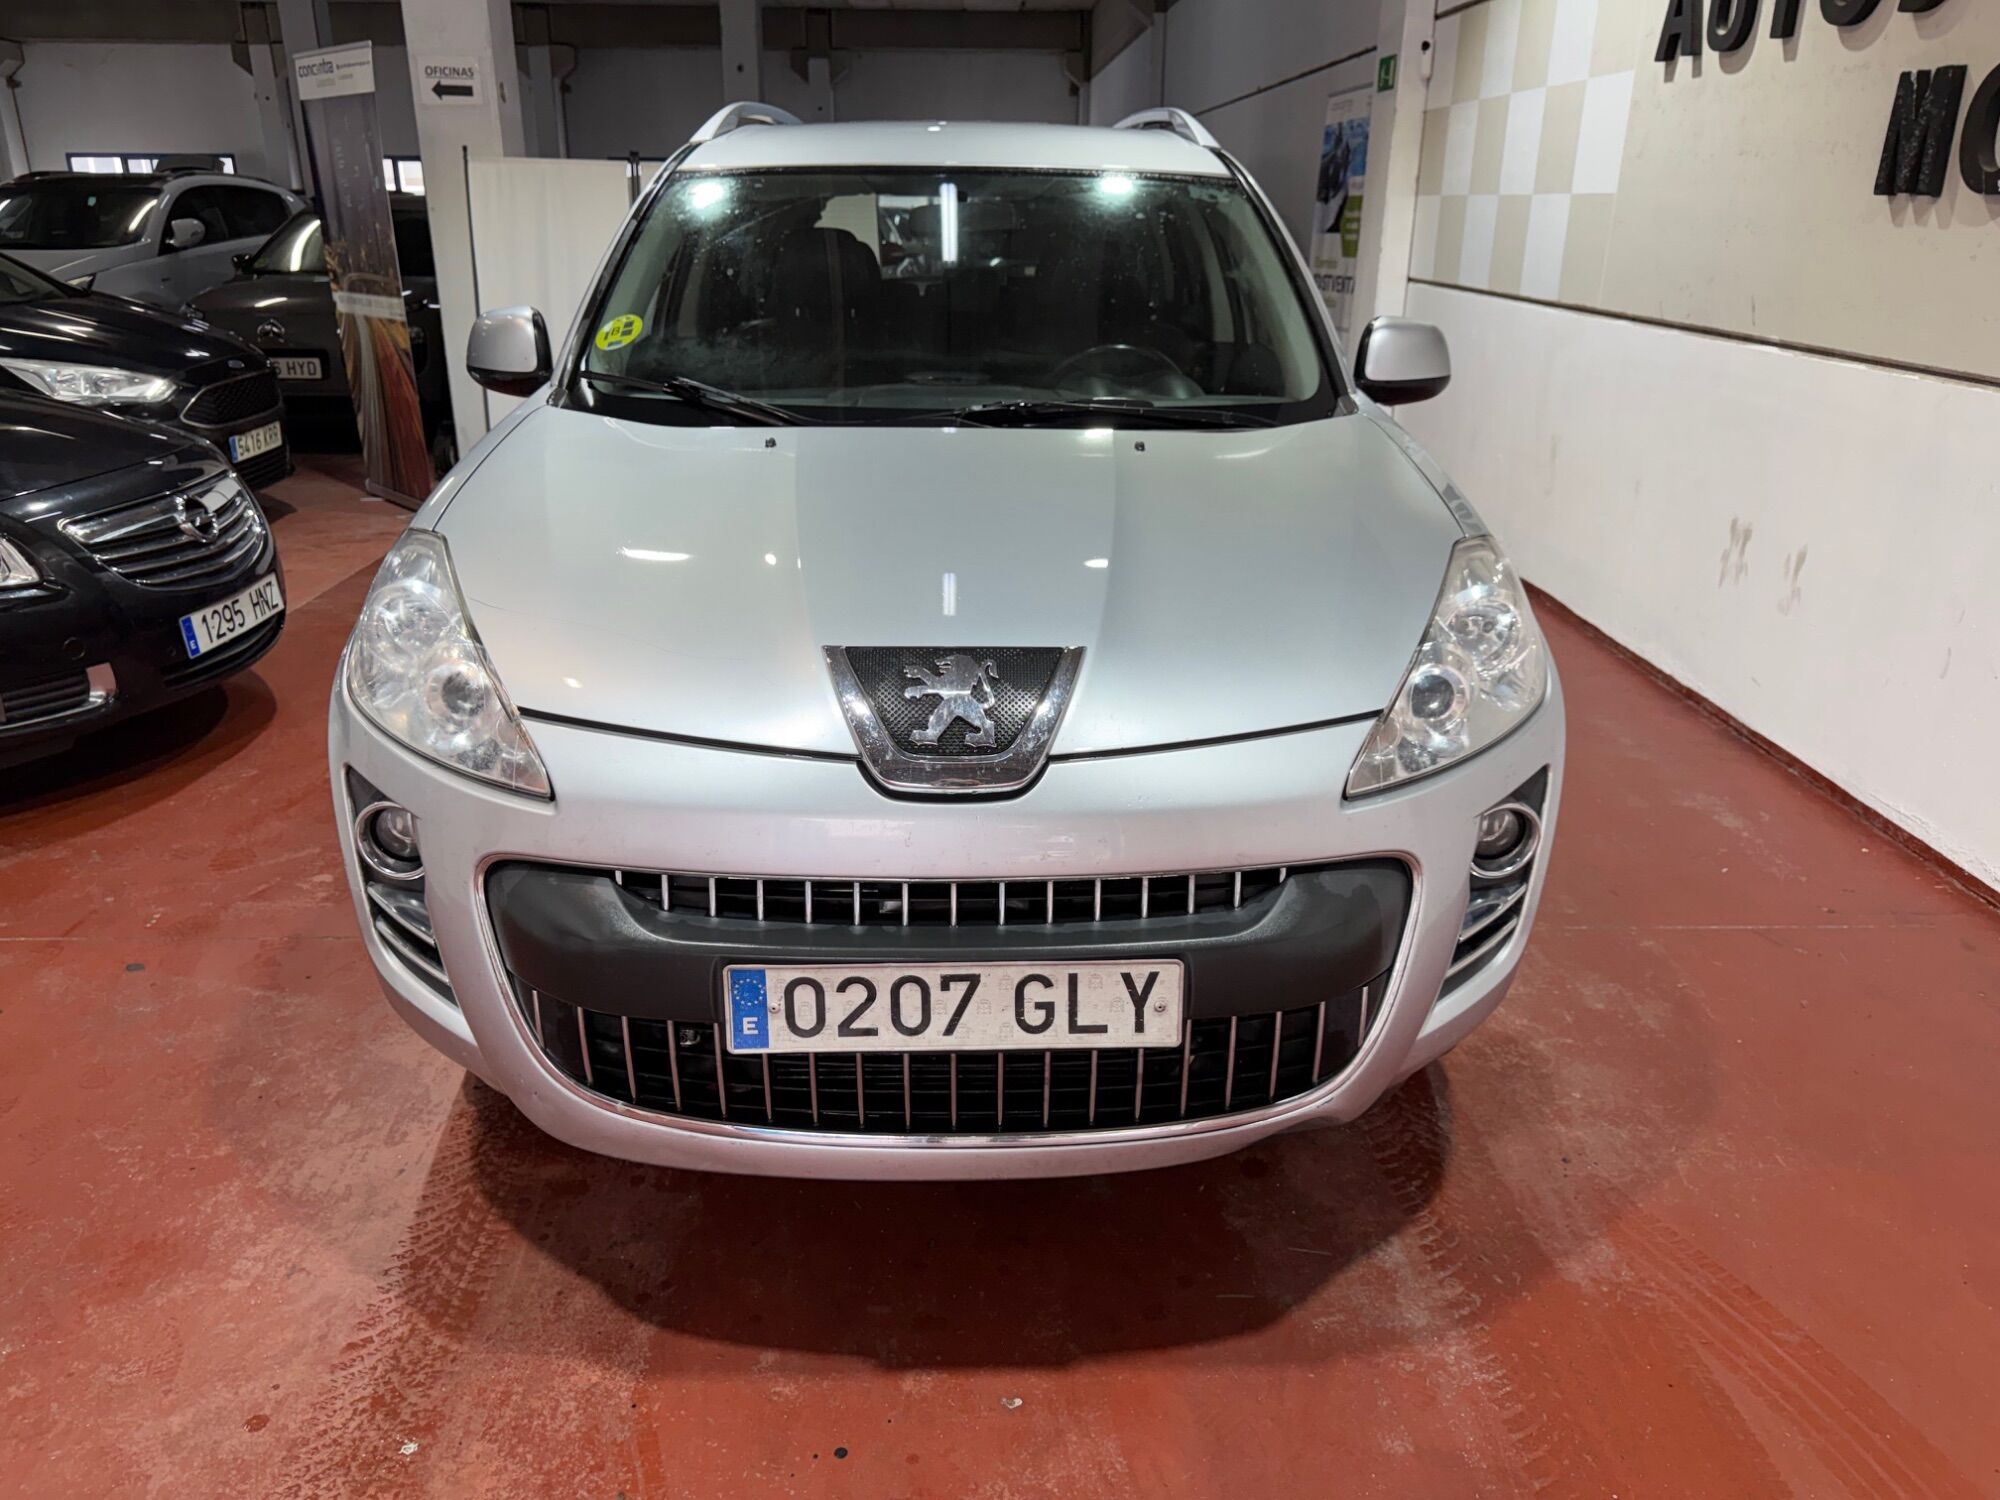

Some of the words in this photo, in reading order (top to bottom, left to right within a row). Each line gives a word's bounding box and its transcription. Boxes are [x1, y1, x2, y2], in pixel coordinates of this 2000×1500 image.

[425, 65, 474, 78] OFICINAS
[286, 360, 317, 377] HYD
[238, 432, 262, 457] 5416
[202, 598, 246, 643] 1295
[249, 581, 279, 620] HNZ
[784, 973, 982, 1037] 0207
[1014, 971, 1160, 1035] GLY
[743, 1017, 759, 1034] E
